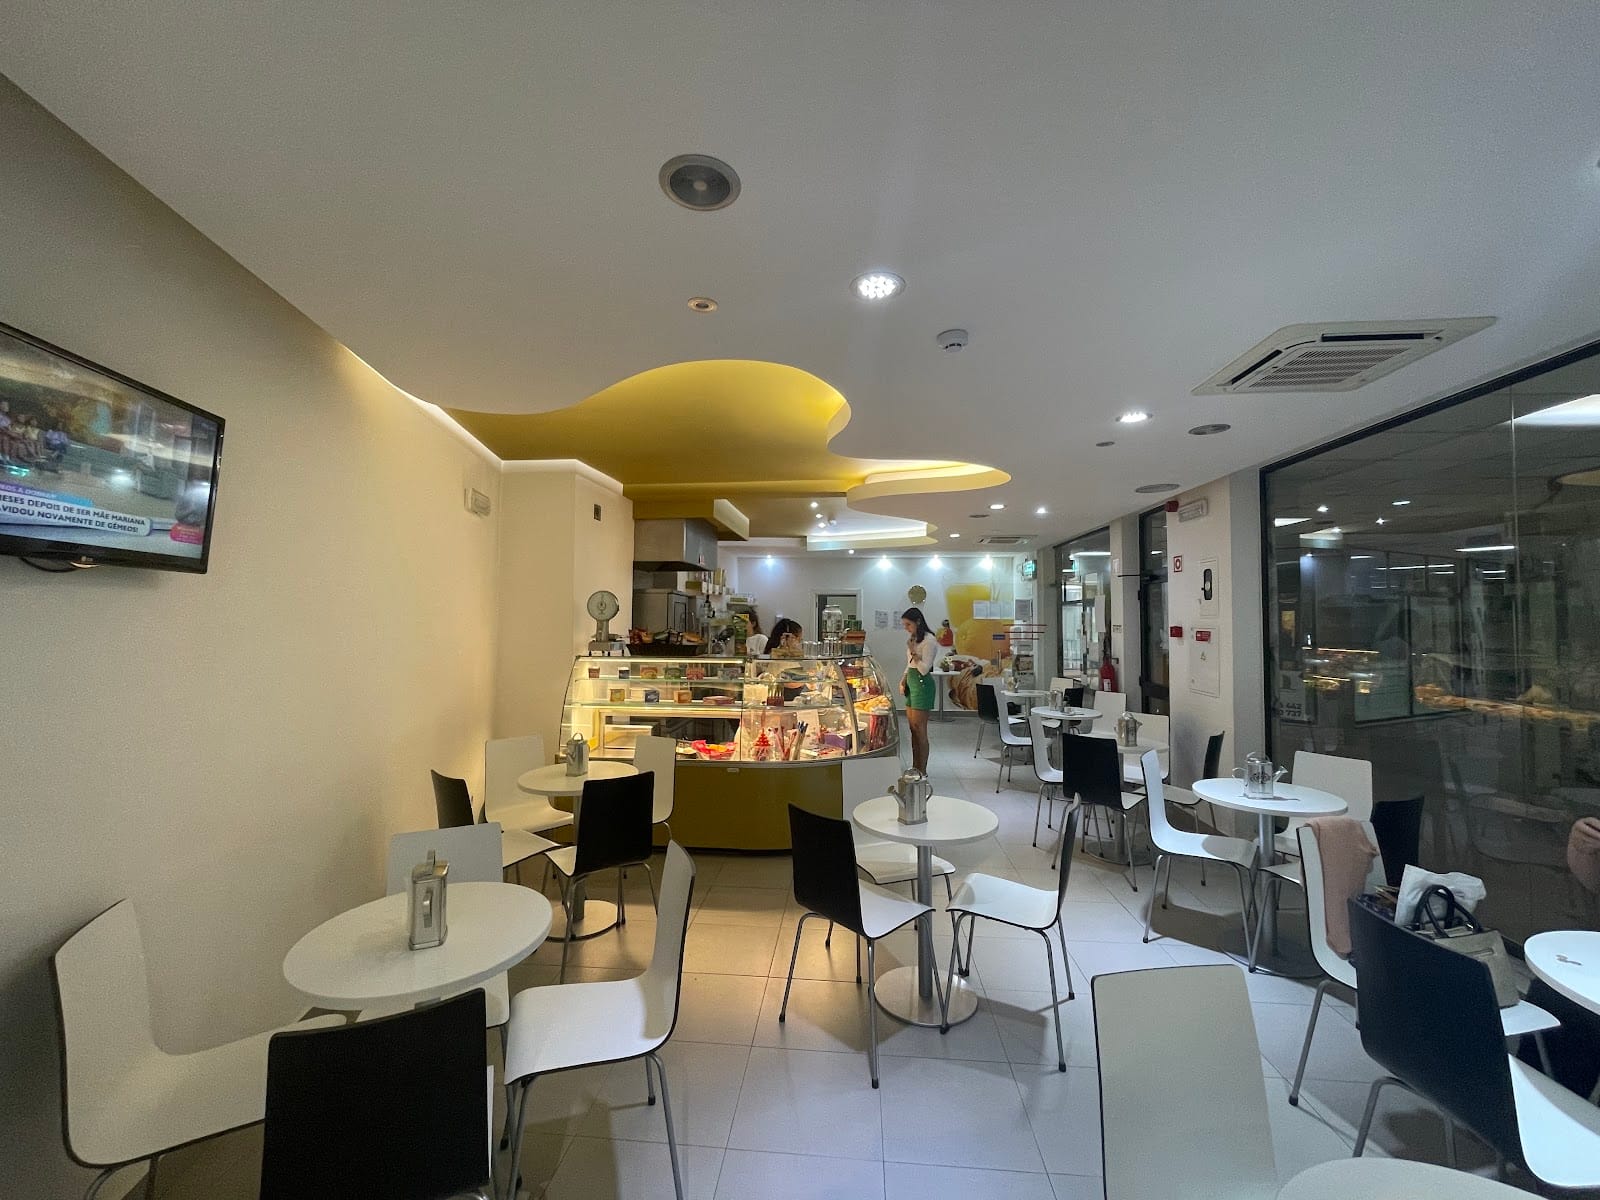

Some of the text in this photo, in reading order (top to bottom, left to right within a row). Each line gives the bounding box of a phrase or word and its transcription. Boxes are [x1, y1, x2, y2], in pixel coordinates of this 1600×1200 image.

[0, 504, 35, 516] VIDOU
[37, 511, 93, 526] NOVAMENTE
[95, 520, 106, 528] DE
[28, 499, 60, 511] DEPOIS
[63, 505, 75, 514] DE
[77, 508, 91, 516] SER
[93, 510, 110, 520] MÃE
[112, 514, 146, 525] MARIANA
